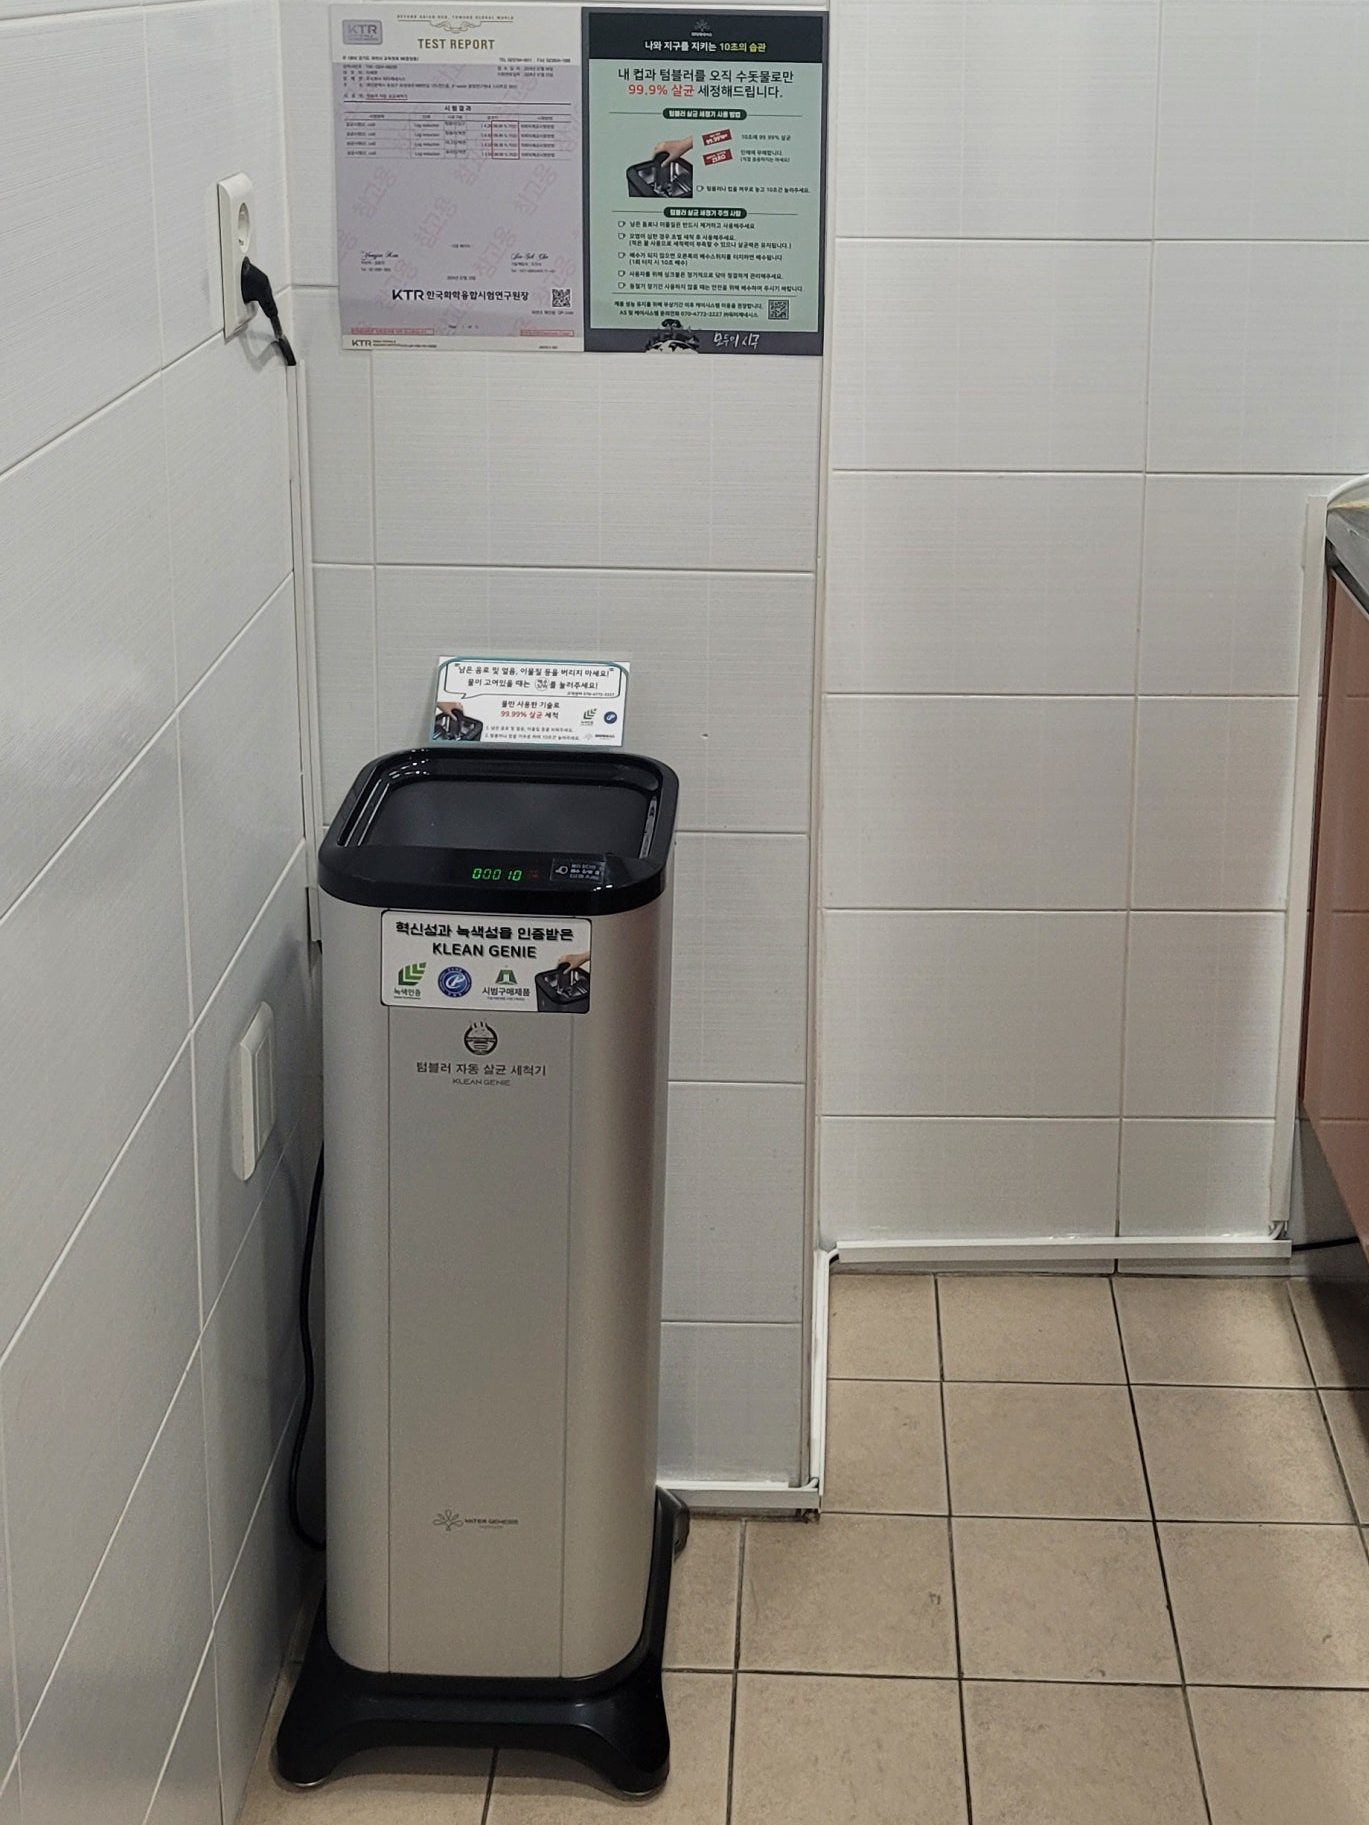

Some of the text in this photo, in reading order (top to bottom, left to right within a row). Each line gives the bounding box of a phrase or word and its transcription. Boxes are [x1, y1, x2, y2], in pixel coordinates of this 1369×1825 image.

[348, 24, 377, 34] KTR
[418, 39, 494, 50] TEST REPORT
[645, 41, 766, 52] 나와 지구를 지키는 10초의 습관
[618, 68, 794, 83] 내 컵과 텀블러를 오직 수돗물로만
[628, 84, 783, 98] 99.9% 살균 세정해드립니다.
[392, 289, 528, 301] KTR 한국화학융합시험연구원장
[476, 666, 489, 674] 음료
[520, 668, 542, 676] 이물질
[545, 668, 558, 676] 등을
[561, 669, 582, 677] 버리지
[468, 678, 482, 686] 물이
[484, 679, 513, 688] 고여있을
[516, 680, 530, 688] 때는
[559, 682, 598, 690] 눌러주세요!
[529, 711, 543, 719] 살균
[396, 921, 574, 941] 혁신성과 녹색성을 인증받은
[432, 942, 537, 959] KLEAN GENIE
[394, 987, 421, 996] 녹색인증
[482, 987, 530, 996] 시범구매제품
[416, 1062, 546, 1076] 텀블러 자동 살균 세척기
